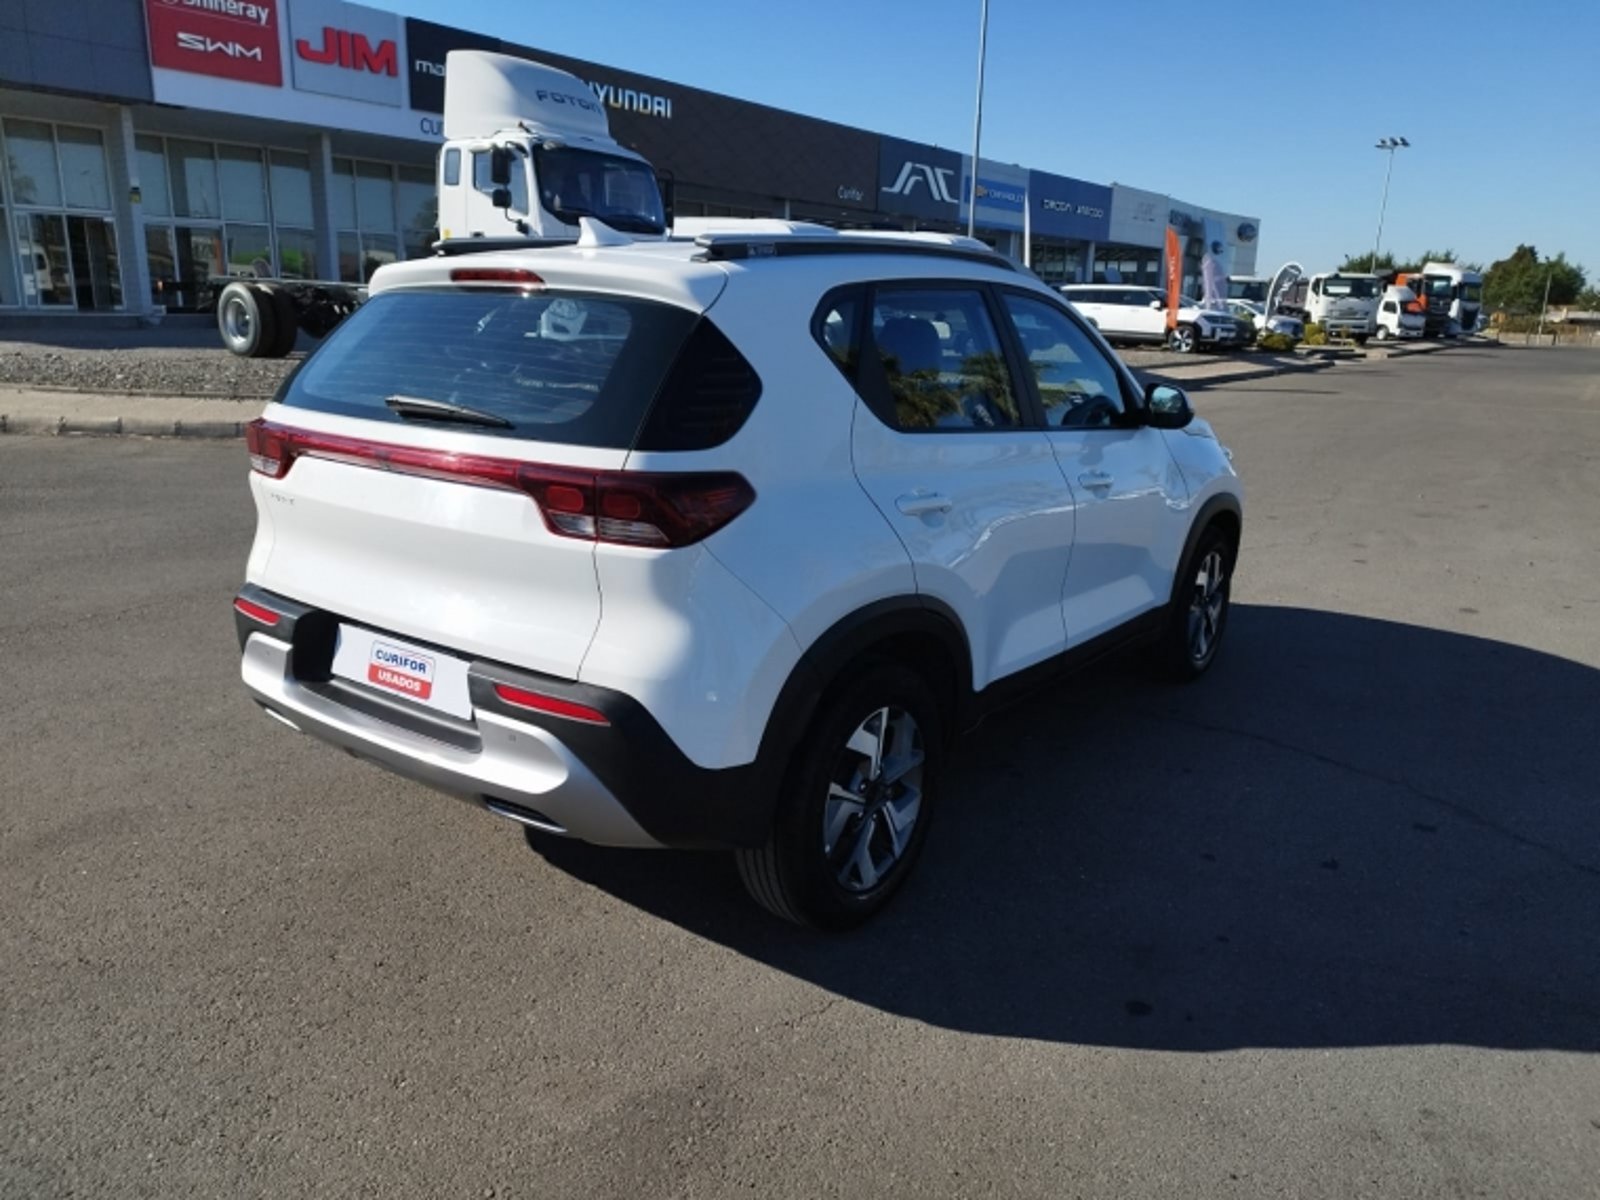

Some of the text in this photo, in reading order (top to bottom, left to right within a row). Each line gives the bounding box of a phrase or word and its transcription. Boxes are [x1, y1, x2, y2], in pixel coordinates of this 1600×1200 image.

[177, 31, 262, 61] SWM
[296, 26, 398, 77] JIM
[588, 81, 672, 119] YUNDAI
[881, 161, 959, 204] JAC
[375, 649, 427, 674] CURIFOR
[378, 669, 421, 692] USADOS
